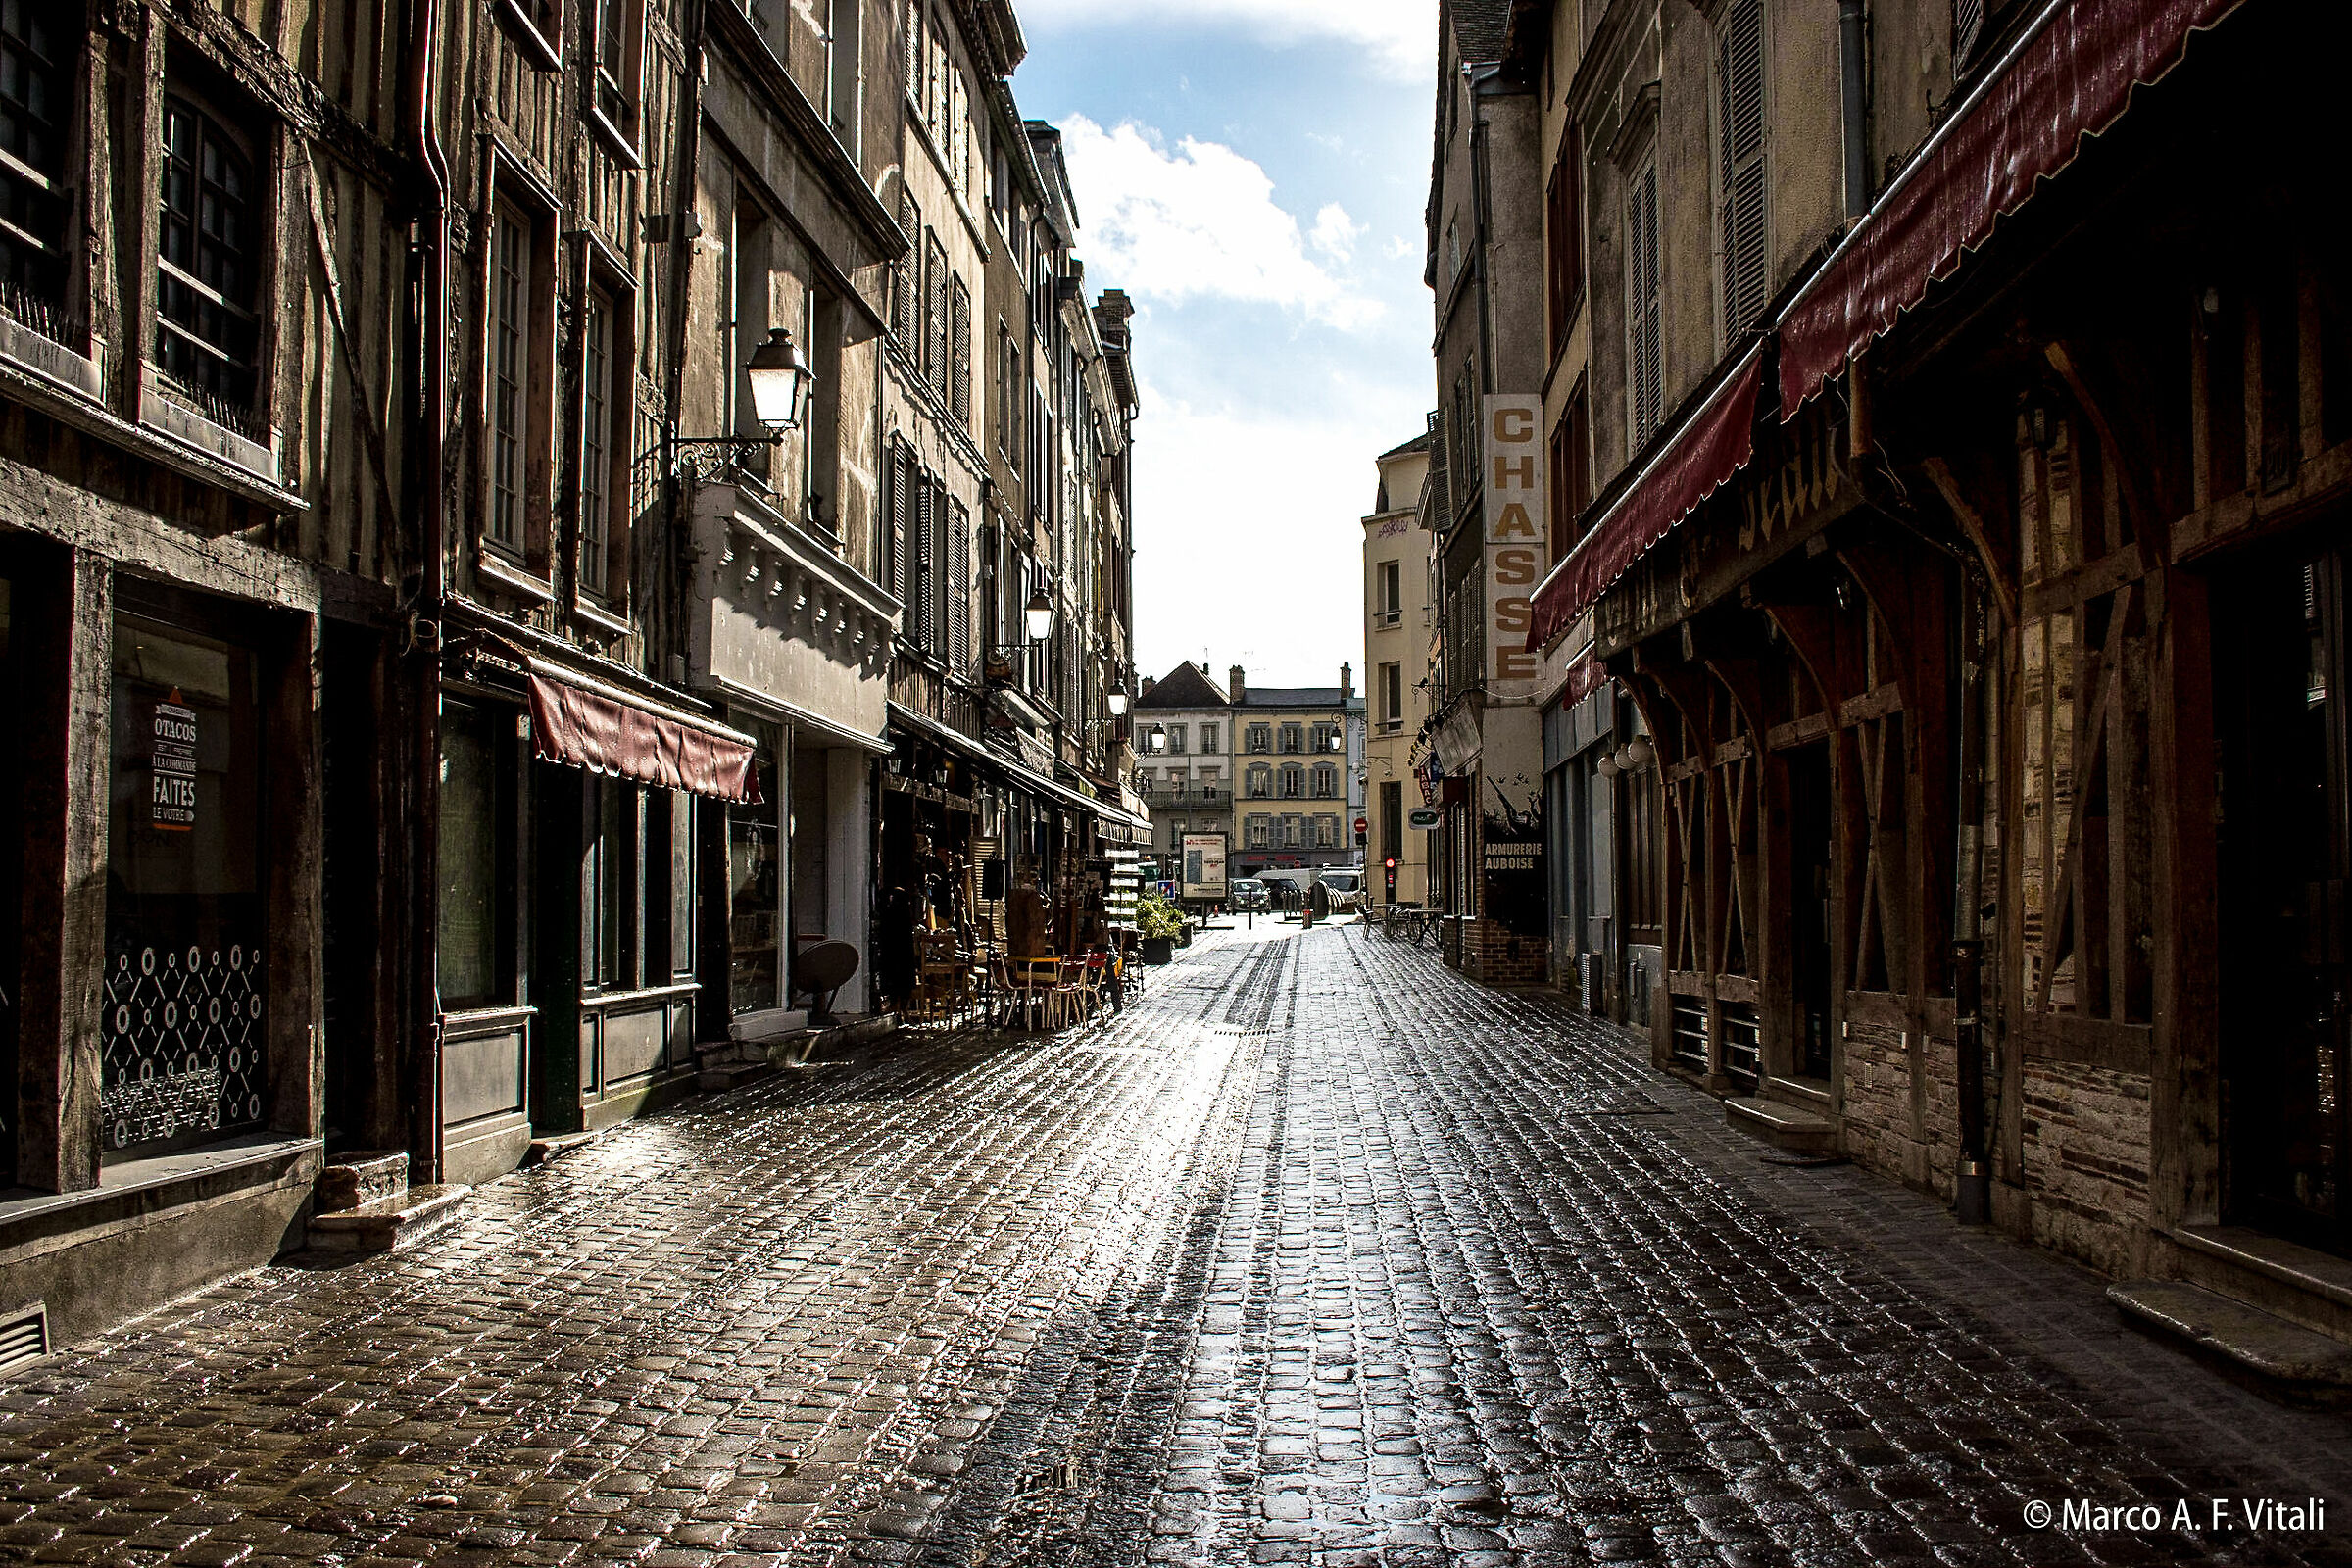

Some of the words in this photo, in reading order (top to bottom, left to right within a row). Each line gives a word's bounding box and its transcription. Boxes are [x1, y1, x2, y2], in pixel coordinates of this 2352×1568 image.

[1494, 408, 1536, 679] CHASSE
[153, 776, 195, 807] FAITES
[1419, 766, 1432, 804] TABAC
[153, 807, 162, 819] LE
[1485, 843, 1542, 856] ARMURERIE
[1485, 858, 1534, 870] AUBOISE
